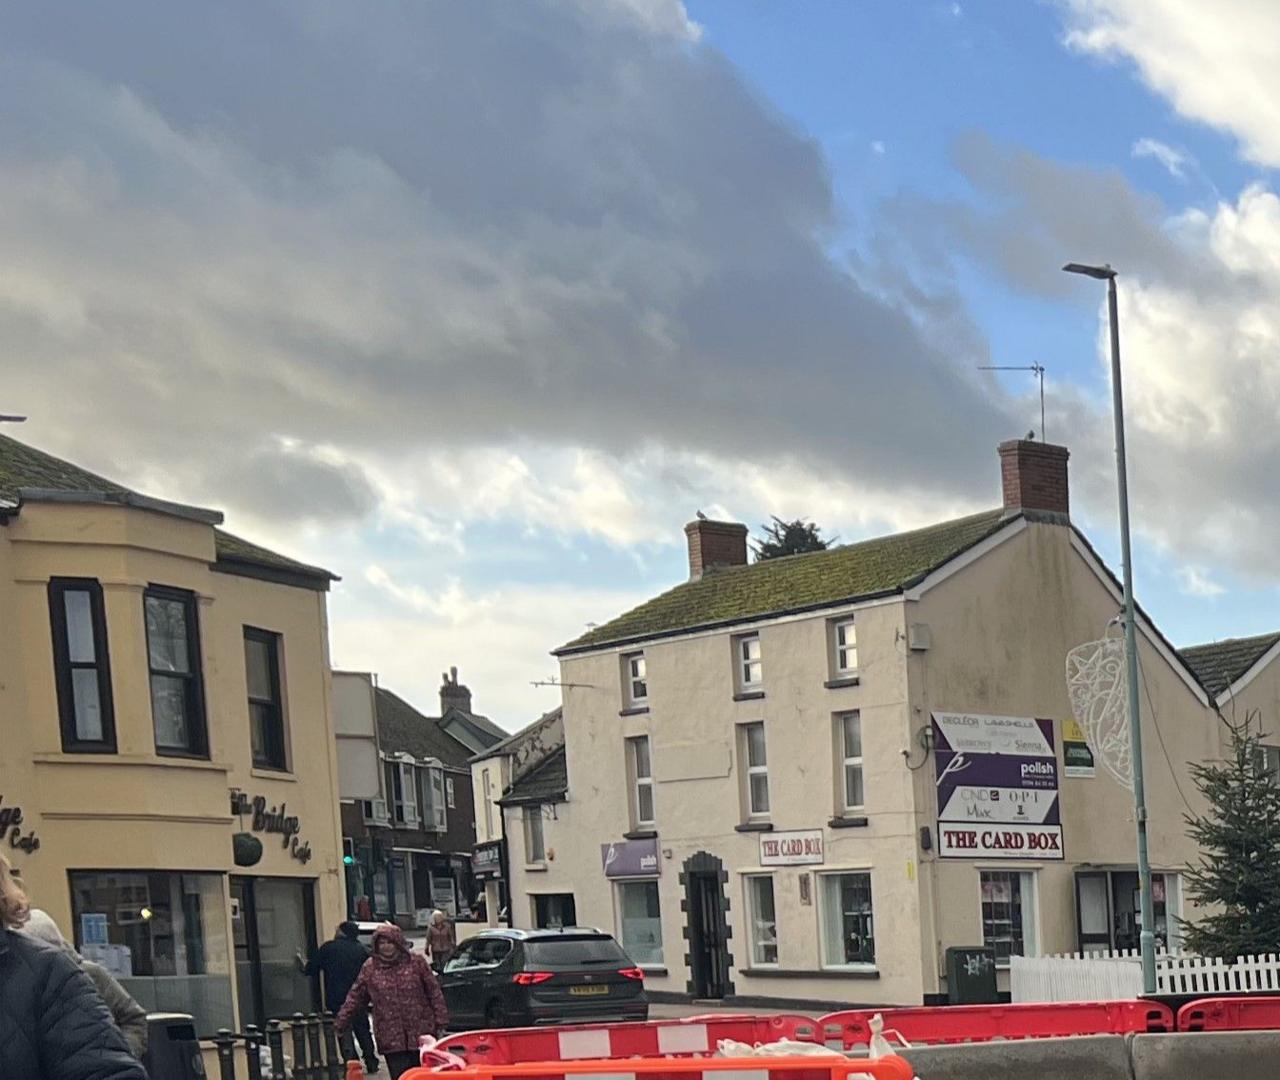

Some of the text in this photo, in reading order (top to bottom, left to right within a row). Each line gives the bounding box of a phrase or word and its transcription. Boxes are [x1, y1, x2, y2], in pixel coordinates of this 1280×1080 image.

[1020, 761, 1055, 778] polish
[252, 795, 301, 849] Bridge
[762, 838, 822, 857] THE CARD BOX
[943, 830, 1060, 850] THE CARD BOX
